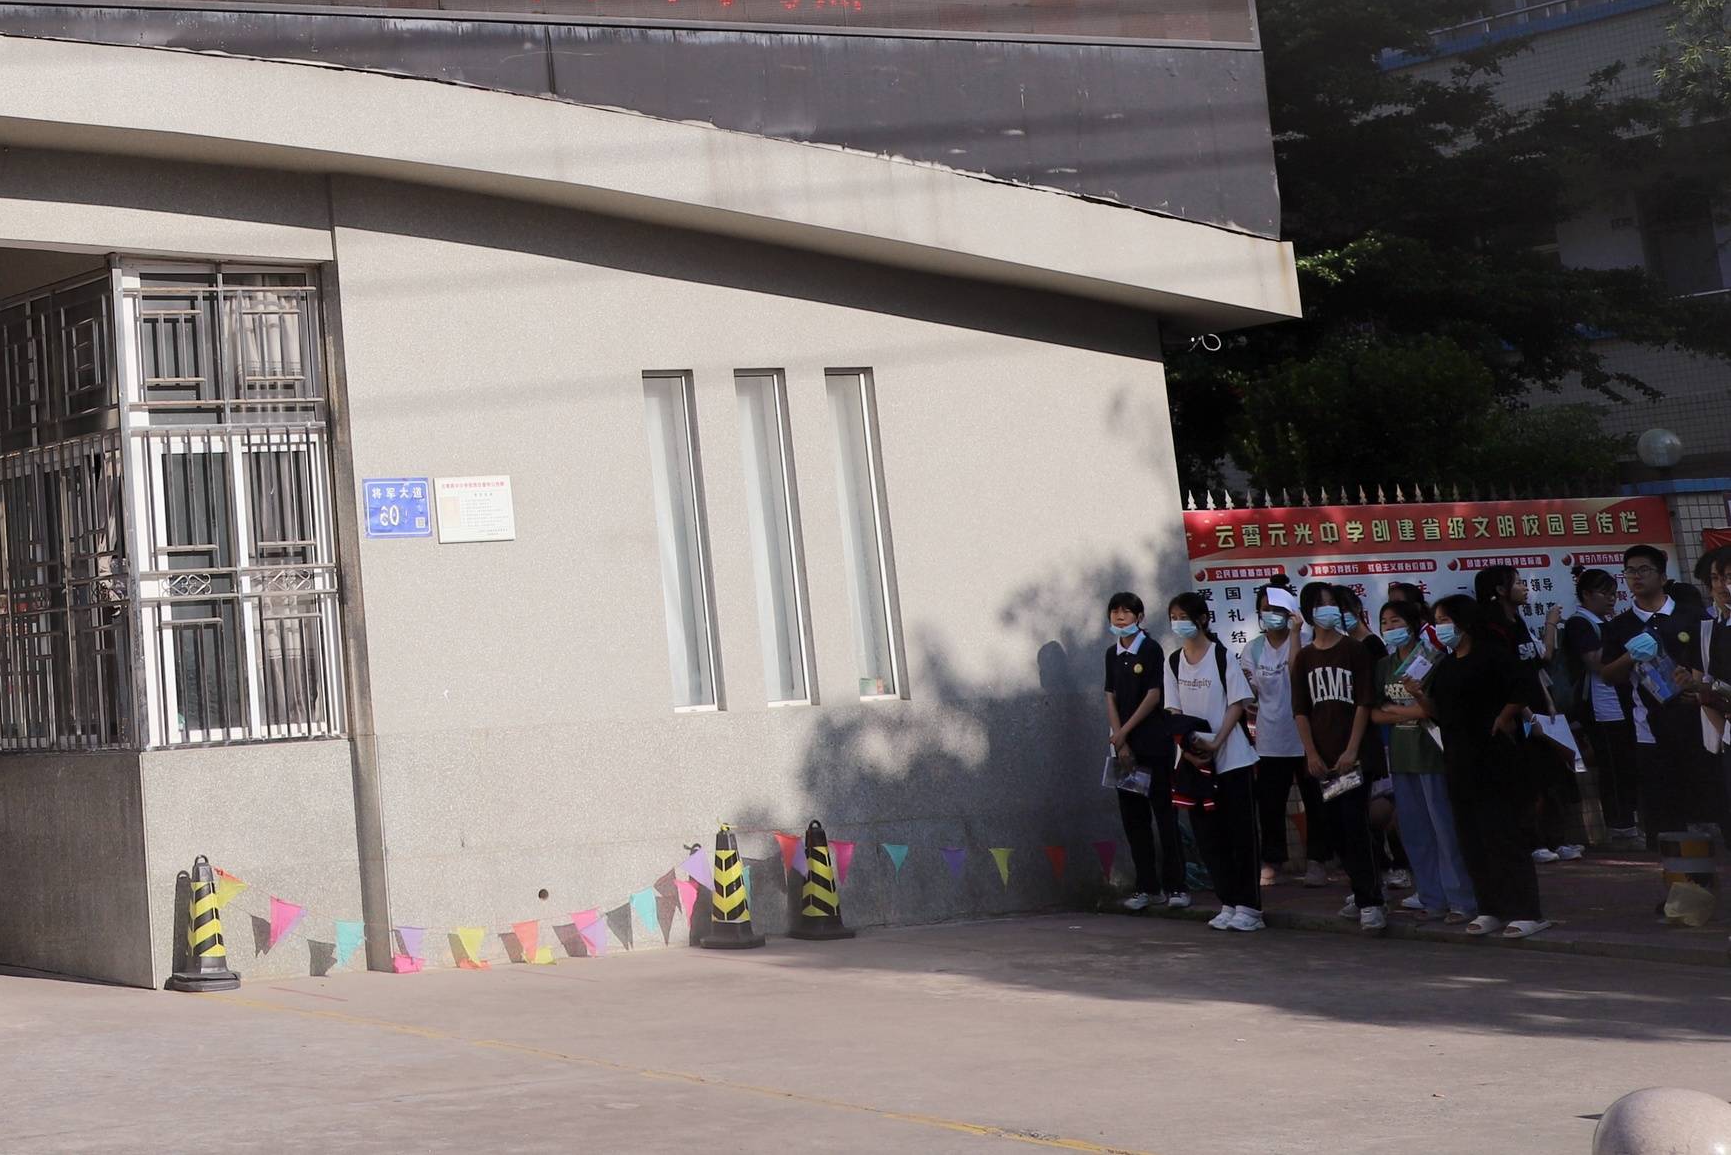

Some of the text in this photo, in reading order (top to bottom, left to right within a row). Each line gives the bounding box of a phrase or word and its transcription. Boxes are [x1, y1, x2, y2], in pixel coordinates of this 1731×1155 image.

[371, 486, 424, 499] 将军大道
[1215, 511, 1640, 550] 云霄元光中学创建省级文明校园宣传栏
